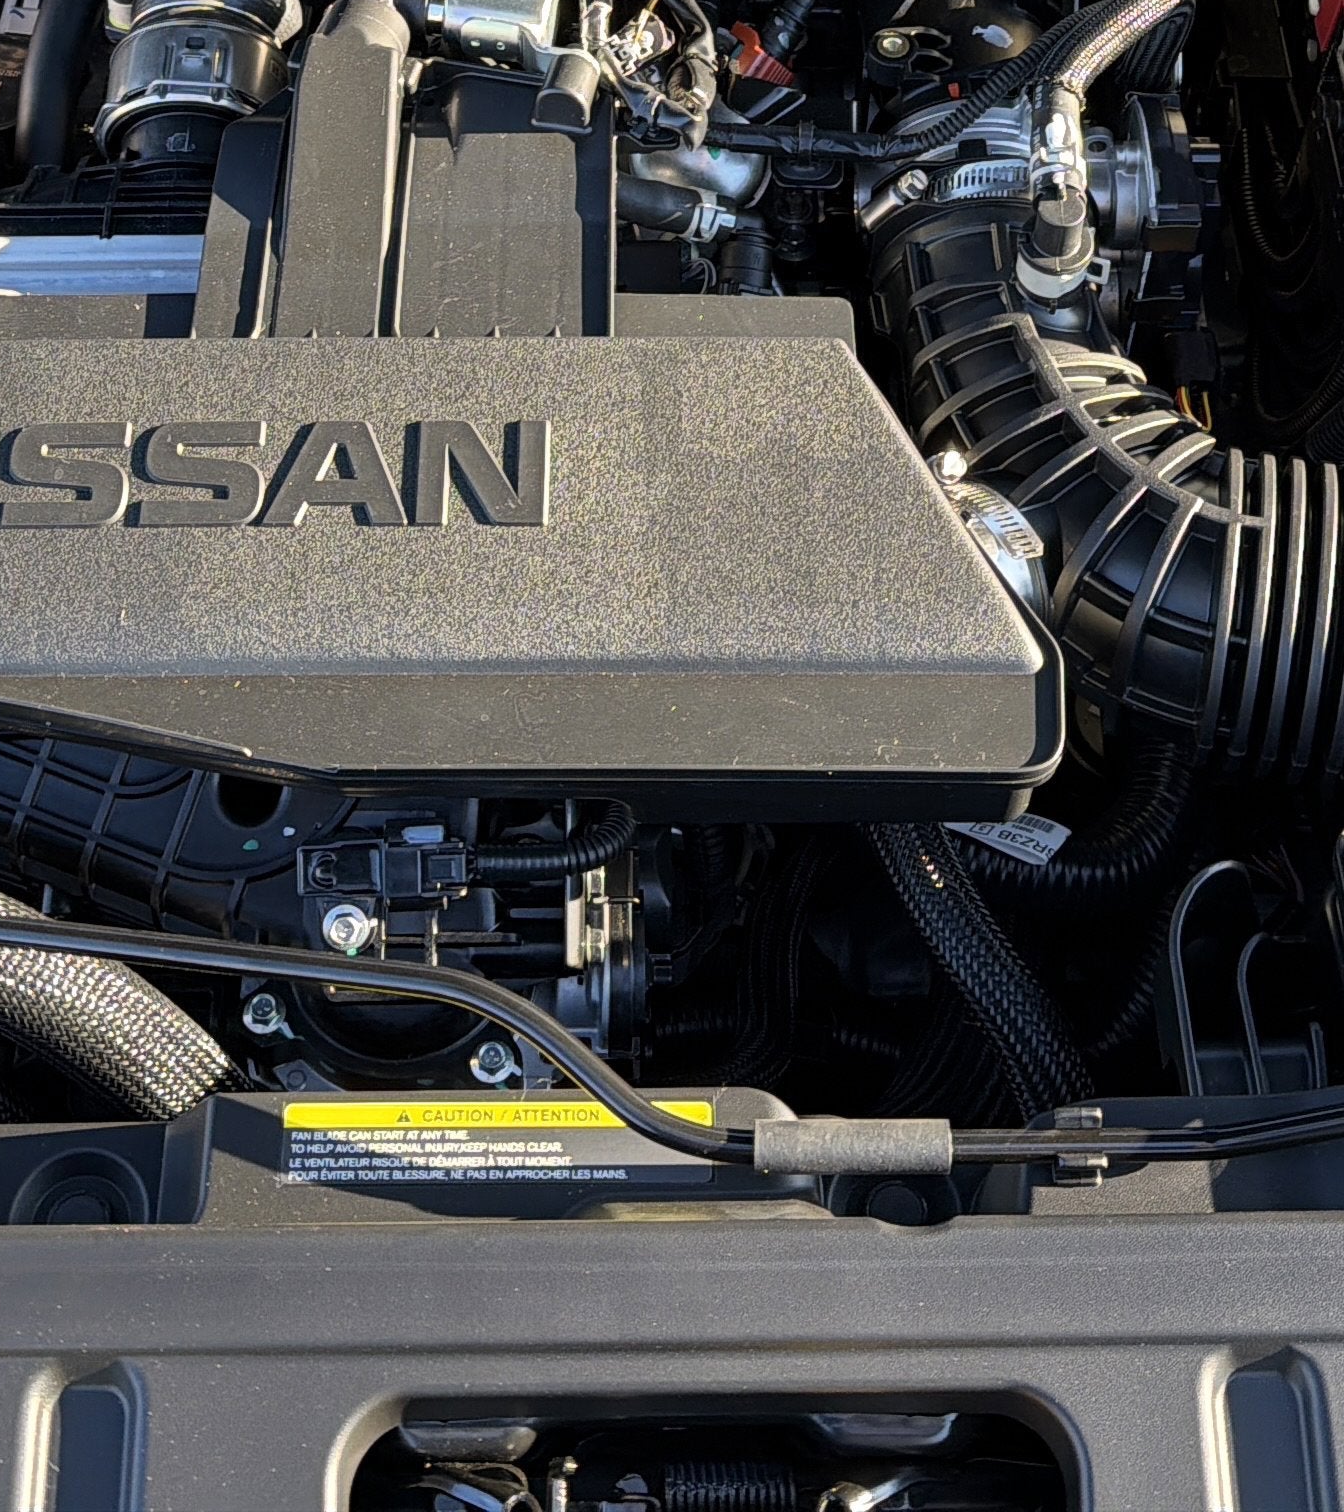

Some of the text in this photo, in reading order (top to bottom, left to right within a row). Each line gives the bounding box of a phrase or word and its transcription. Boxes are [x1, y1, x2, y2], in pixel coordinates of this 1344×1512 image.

[422, 1109, 493, 1122] CAUTION
[512, 1108, 600, 1122] ATTENTION
[291, 1131, 313, 1141] FAN
[313, 1130, 347, 1140] BLADE
[348, 1130, 371, 1140] CAN
[372, 1130, 405, 1140] START
[405, 1130, 420, 1140] AT
[420, 1130, 444, 1140] ANY
[290, 1143, 305, 1154] TO
[307, 1143, 334, 1153] HELP
[334, 1143, 367, 1153] AVOID
[368, 1143, 424, 1153] PERSONAL
[488, 1142, 526, 1152] HANDS
[526, 1142, 564, 1152] CLEAR.
[289, 1158, 302, 1168] LE
[303, 1157, 370, 1168] VENTILATEUR
[371, 1157, 412, 1167] RISQUE
[412, 1157, 428, 1167] DE
[428, 1154, 486, 1167] DÉMARRER
[496, 1156, 525, 1166] TOUT
[525, 1156, 573, 1167] MOMENT.
[287, 1168, 629, 1182] POUR ÉVITER TOUTE BLESSURE, NE PAS EN APPROCHER LES MAINS.
